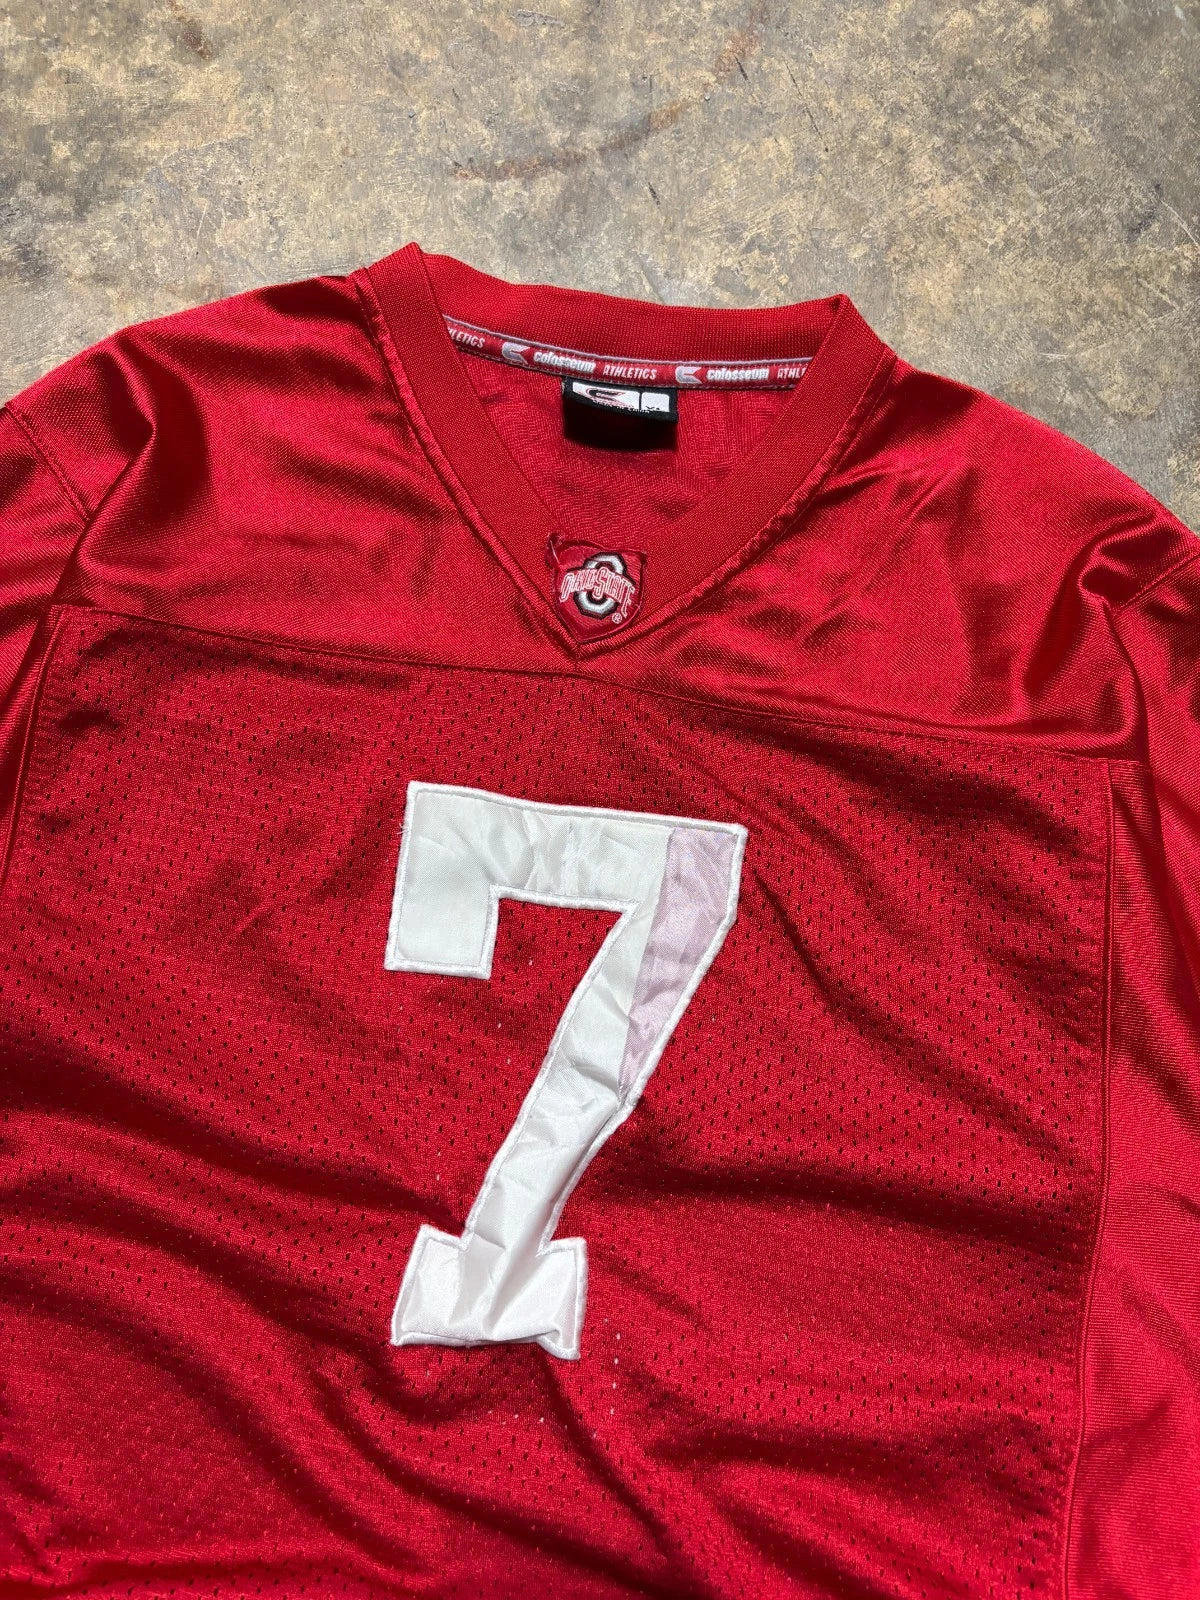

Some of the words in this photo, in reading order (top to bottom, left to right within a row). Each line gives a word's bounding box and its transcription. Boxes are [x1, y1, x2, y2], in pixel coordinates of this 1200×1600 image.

[532, 351, 597, 374] colosseum
[602, 364, 658, 381] ATHLETICS
[705, 366, 770, 382] colosseum
[384, 781, 748, 1360] 7
